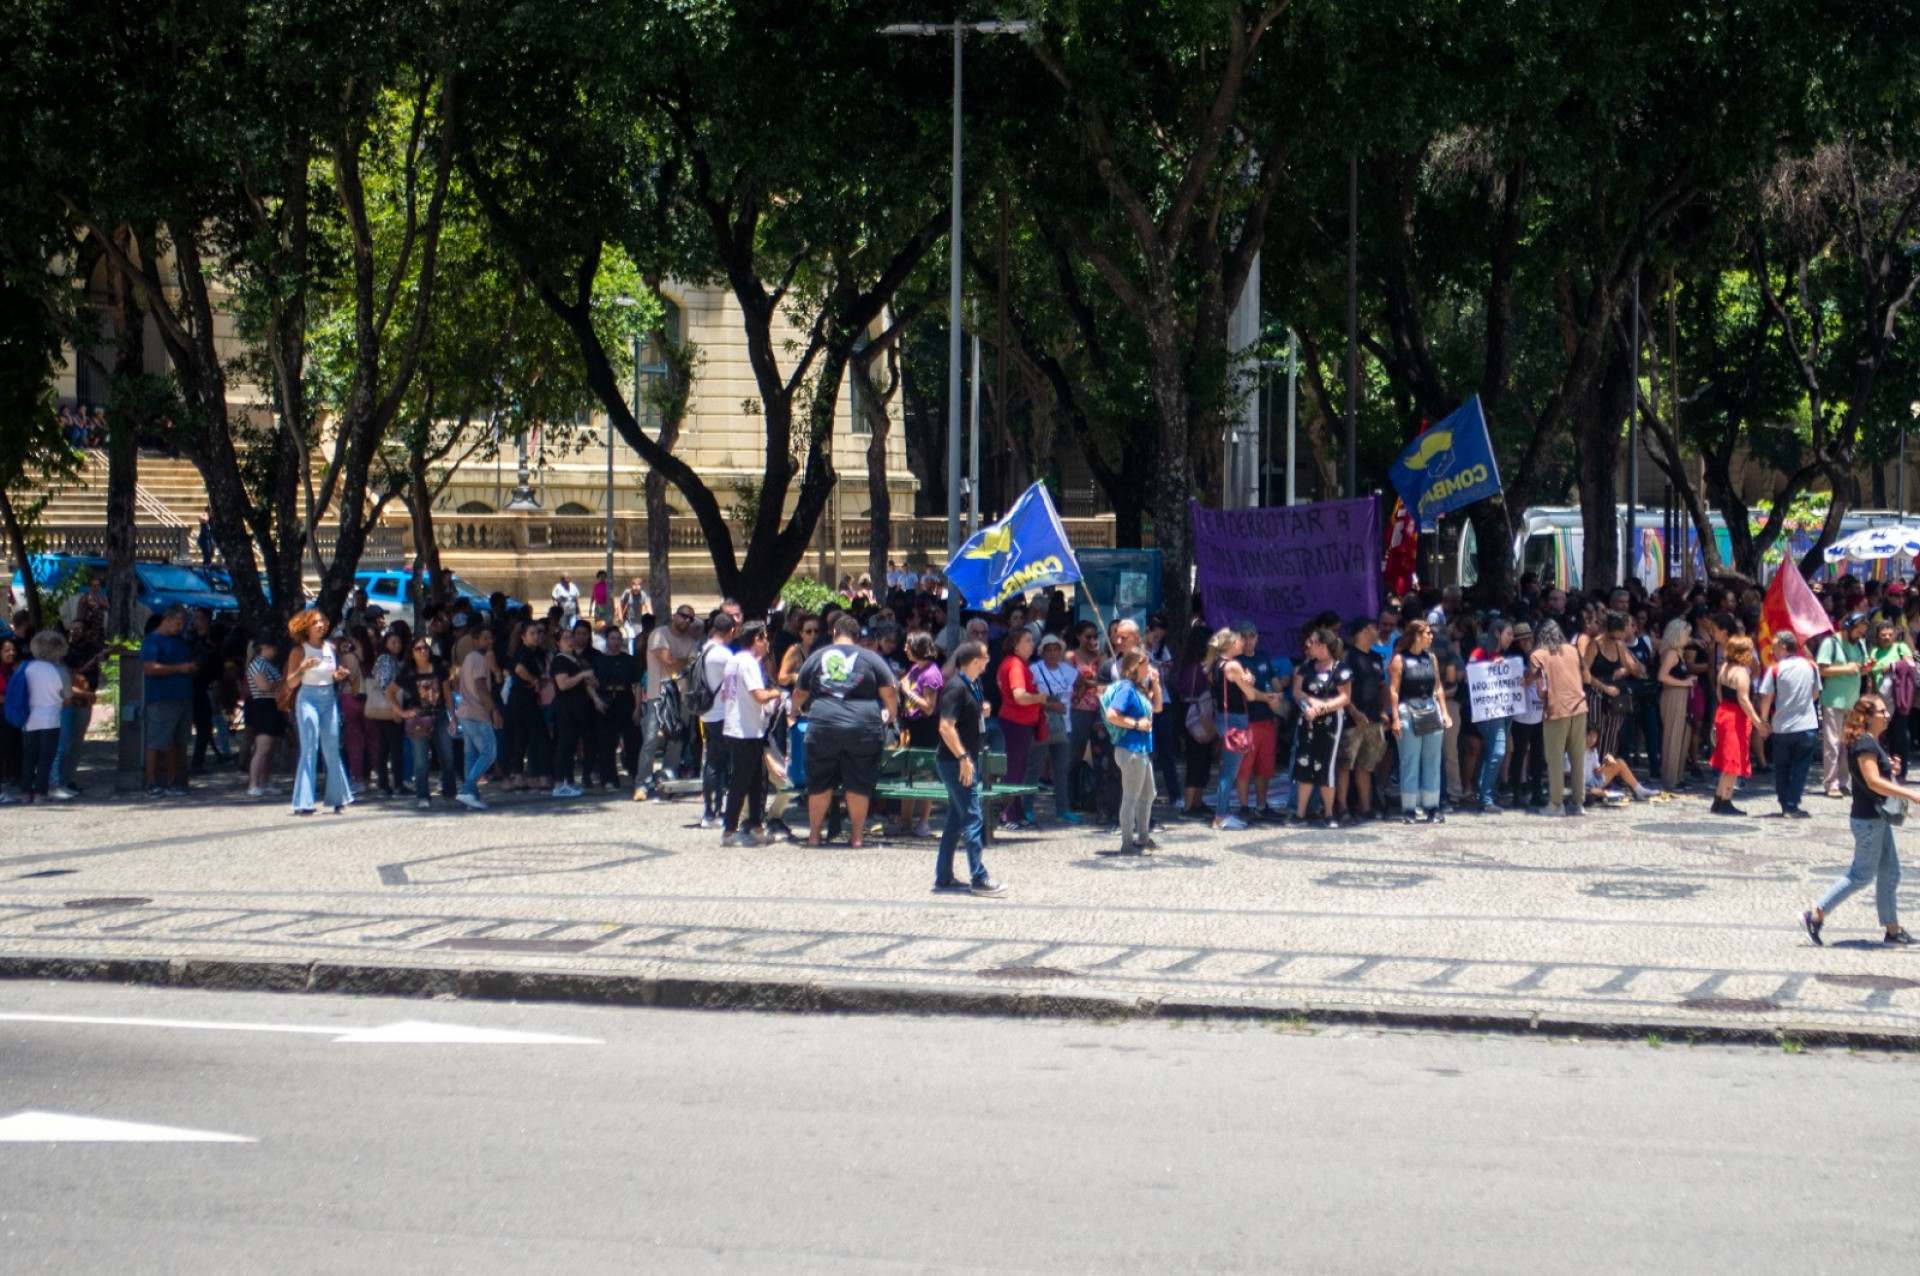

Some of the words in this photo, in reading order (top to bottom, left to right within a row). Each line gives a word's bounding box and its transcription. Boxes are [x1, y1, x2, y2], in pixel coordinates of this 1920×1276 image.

[1228, 508, 1325, 539] DERROTAR
[1336, 508, 1351, 531] A
[1487, 664, 1510, 676] PELO
